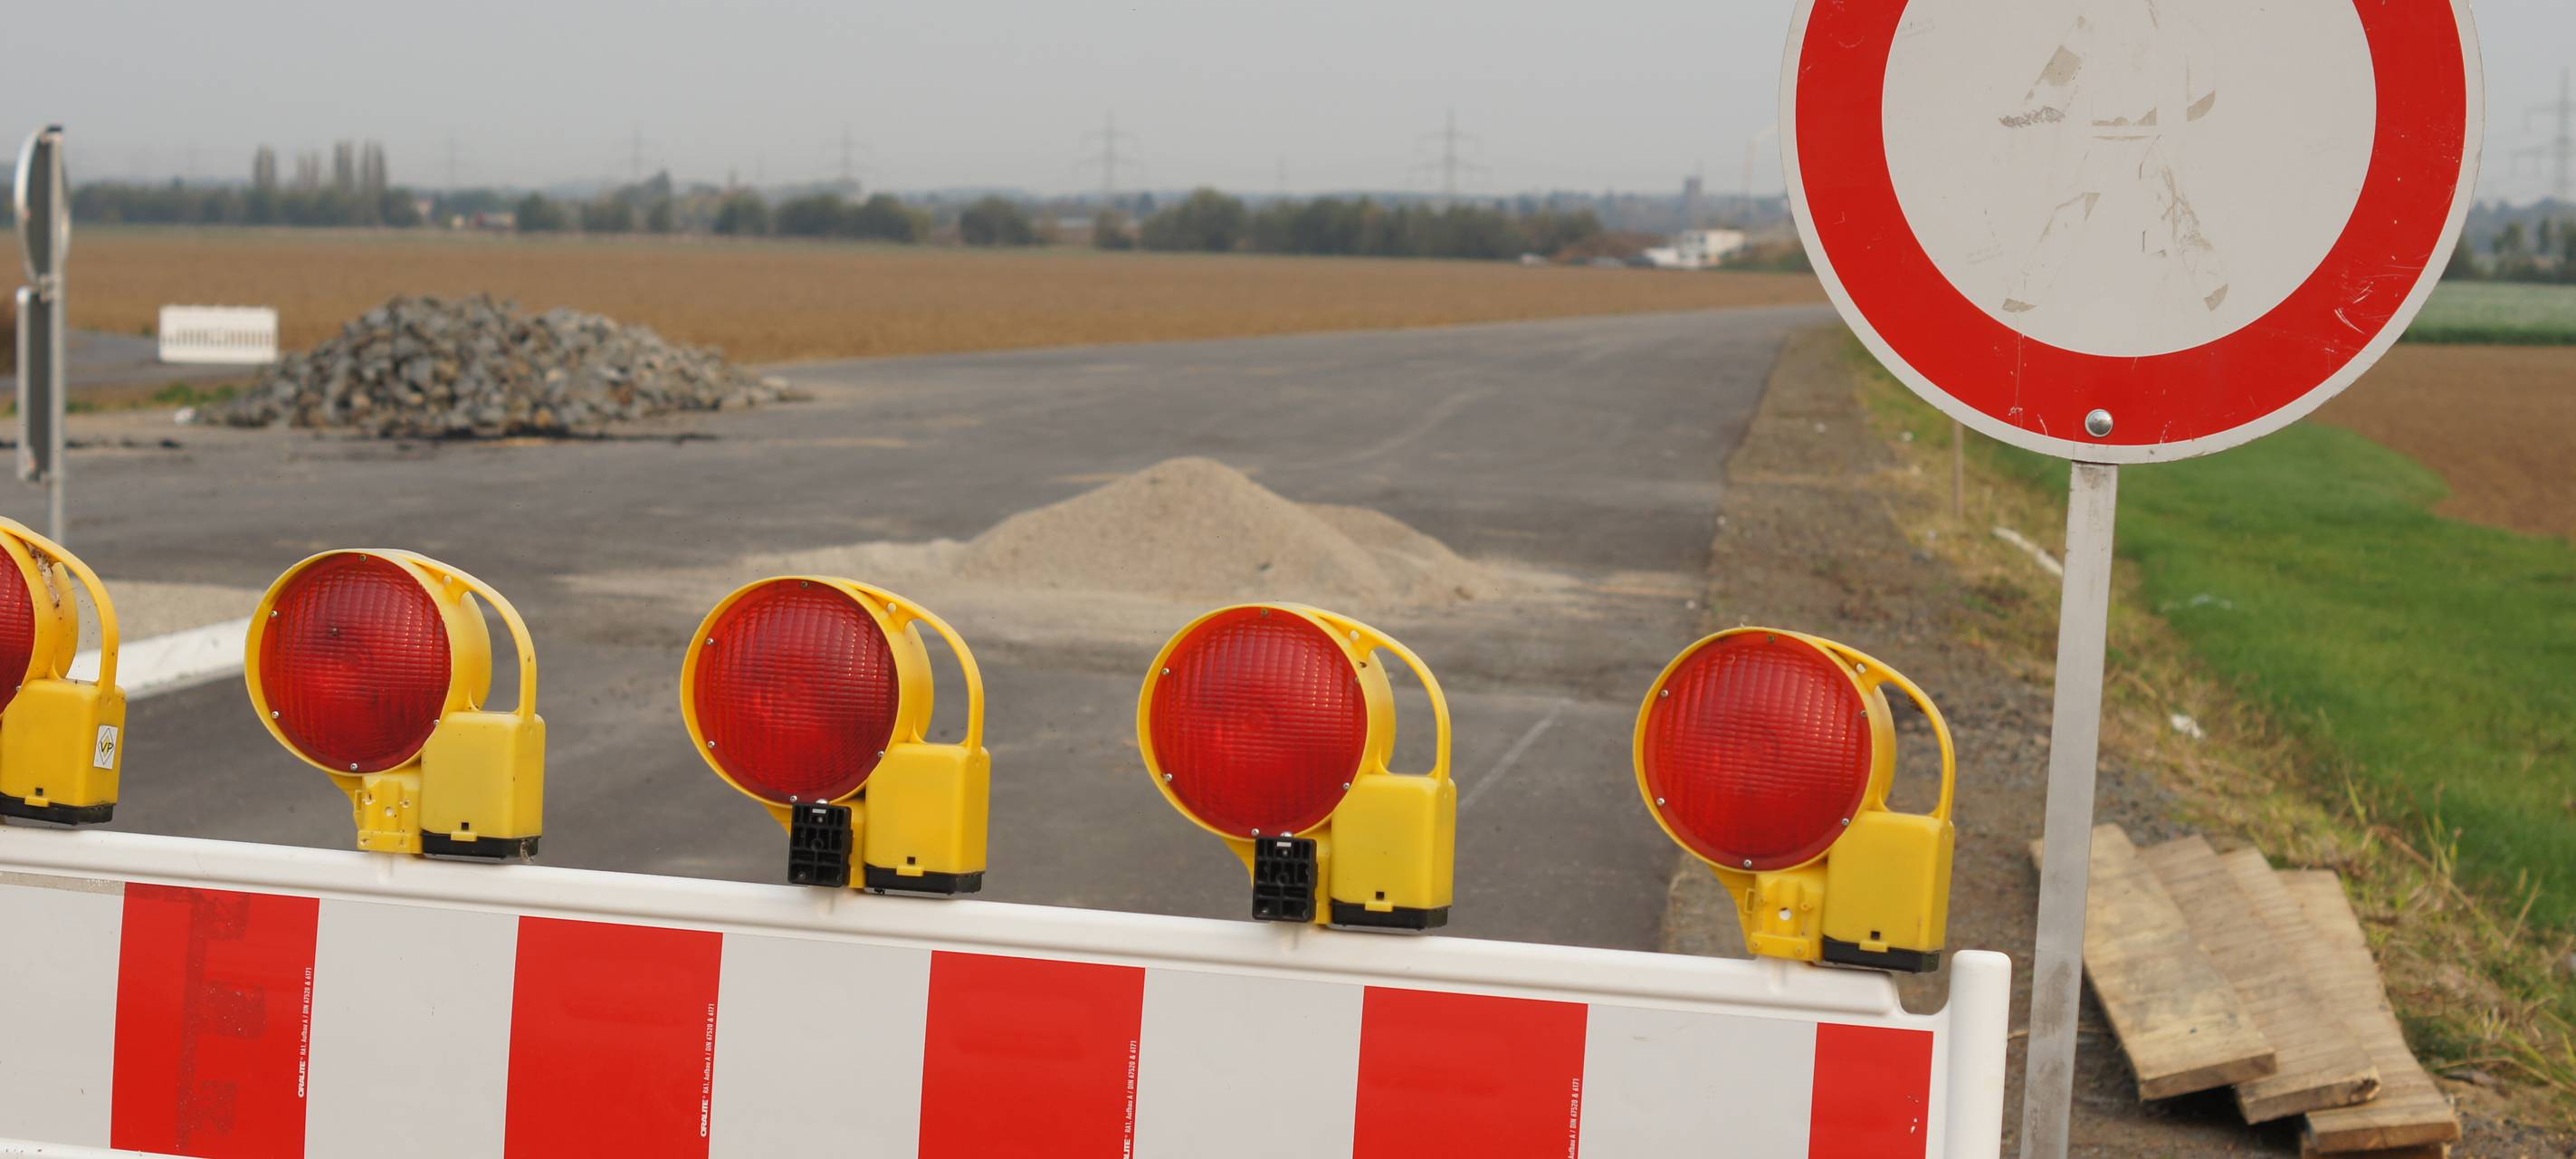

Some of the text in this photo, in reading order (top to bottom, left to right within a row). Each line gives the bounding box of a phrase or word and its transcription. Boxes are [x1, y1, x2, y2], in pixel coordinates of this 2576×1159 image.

[100, 742, 114, 753] VP
[707, 1003, 715, 1016] 6171
[1129, 1040, 1137, 1053] 6171
[1571, 1078, 1579, 1091] 6171
[1569, 1118, 1577, 1128] DIN
